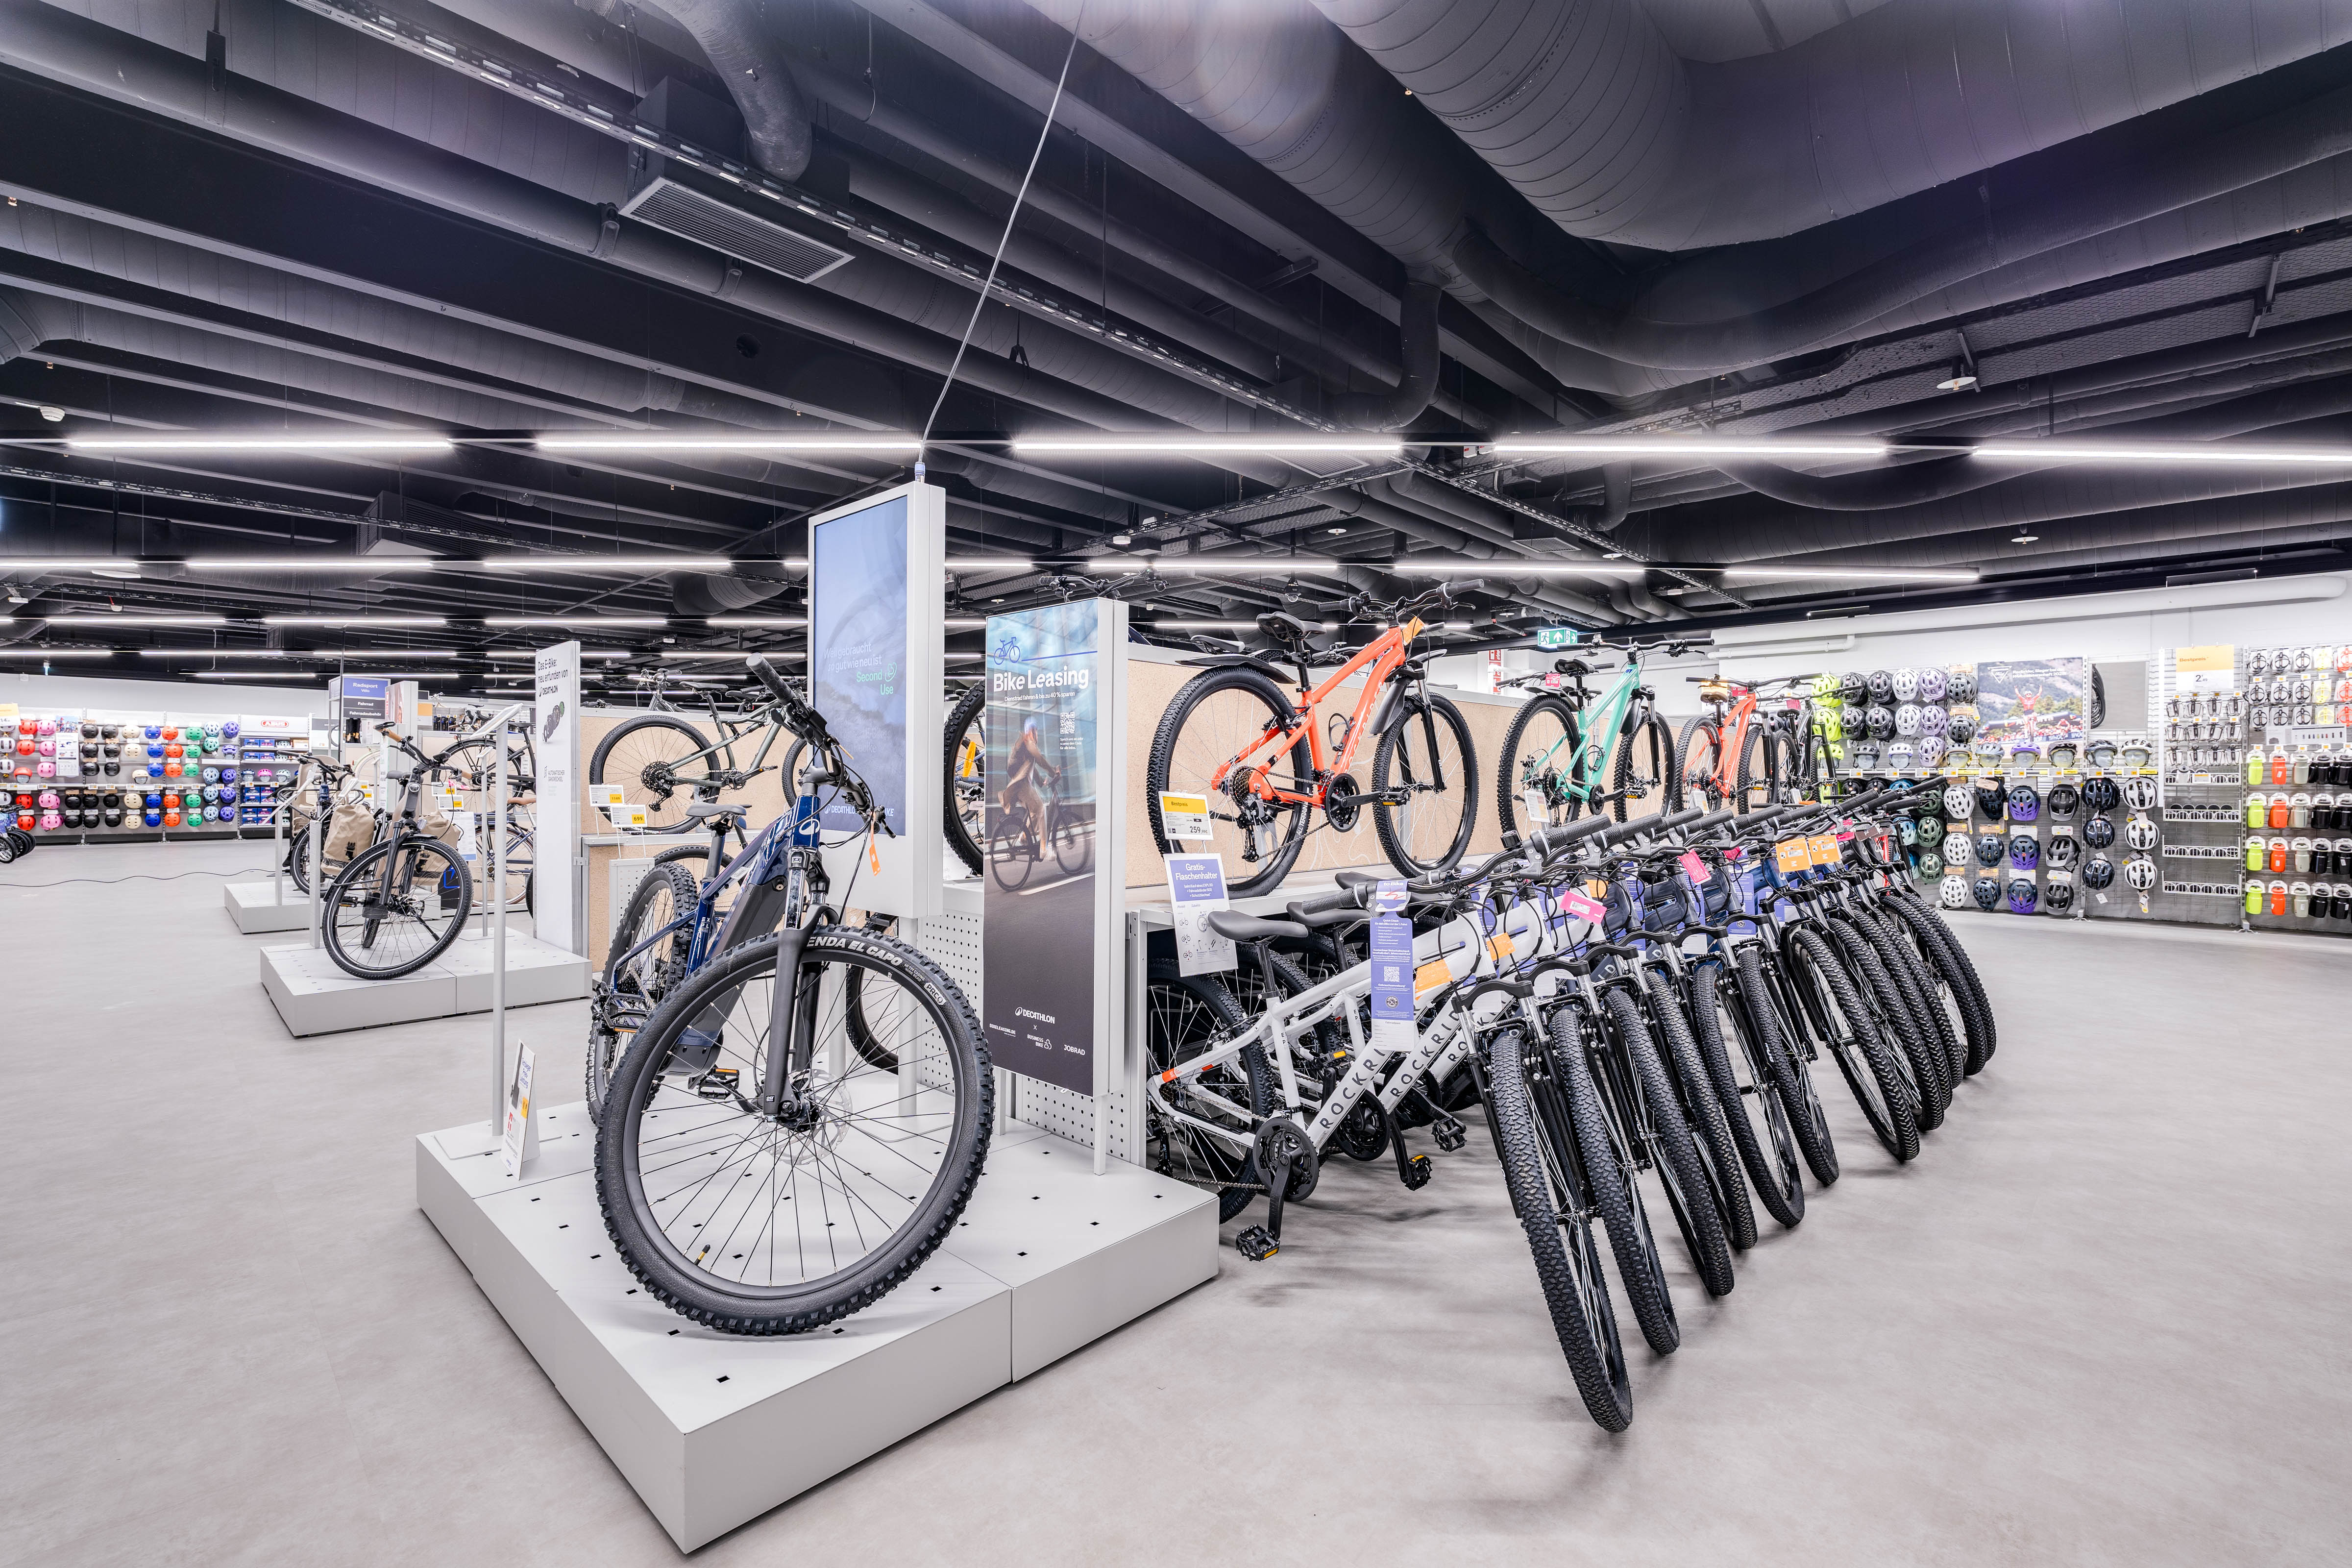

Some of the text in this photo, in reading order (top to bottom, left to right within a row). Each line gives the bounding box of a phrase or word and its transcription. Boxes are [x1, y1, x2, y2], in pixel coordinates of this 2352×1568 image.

[824, 641, 872, 659] Weil gebraucht
[545, 658, 557, 669] E-Bike:
[828, 654, 882, 673] so gut wie neu ist
[545, 670, 561, 682] erfunden
[856, 668, 882, 683] Second
[993, 665, 1089, 692] Bike Leasing
[542, 685, 558, 695] DECATHLON
[880, 684, 894, 695] Use
[831, 805, 858, 815] DECATHLO
[1298, 805, 1309, 827] TERRAIN
[1185, 863, 1206, 871] Gratis-
[1175, 872, 1218, 881] Flaschenhalter
[807, 936, 903, 966] ENDA EL CAPO
[913, 970, 926, 981] CASING
[1023, 1009, 1055, 1024] DECATHLON
[989, 1023, 1016, 1035] BIKELEASING.DE
[1027, 1034, 1044, 1043] BUSINESS
[1063, 1044, 1085, 1055] JOBRAD
[1390, 1010, 1459, 1097] ROCKRID
[588, 1067, 594, 1077] EL
[588, 1077, 597, 1102] KENDA
